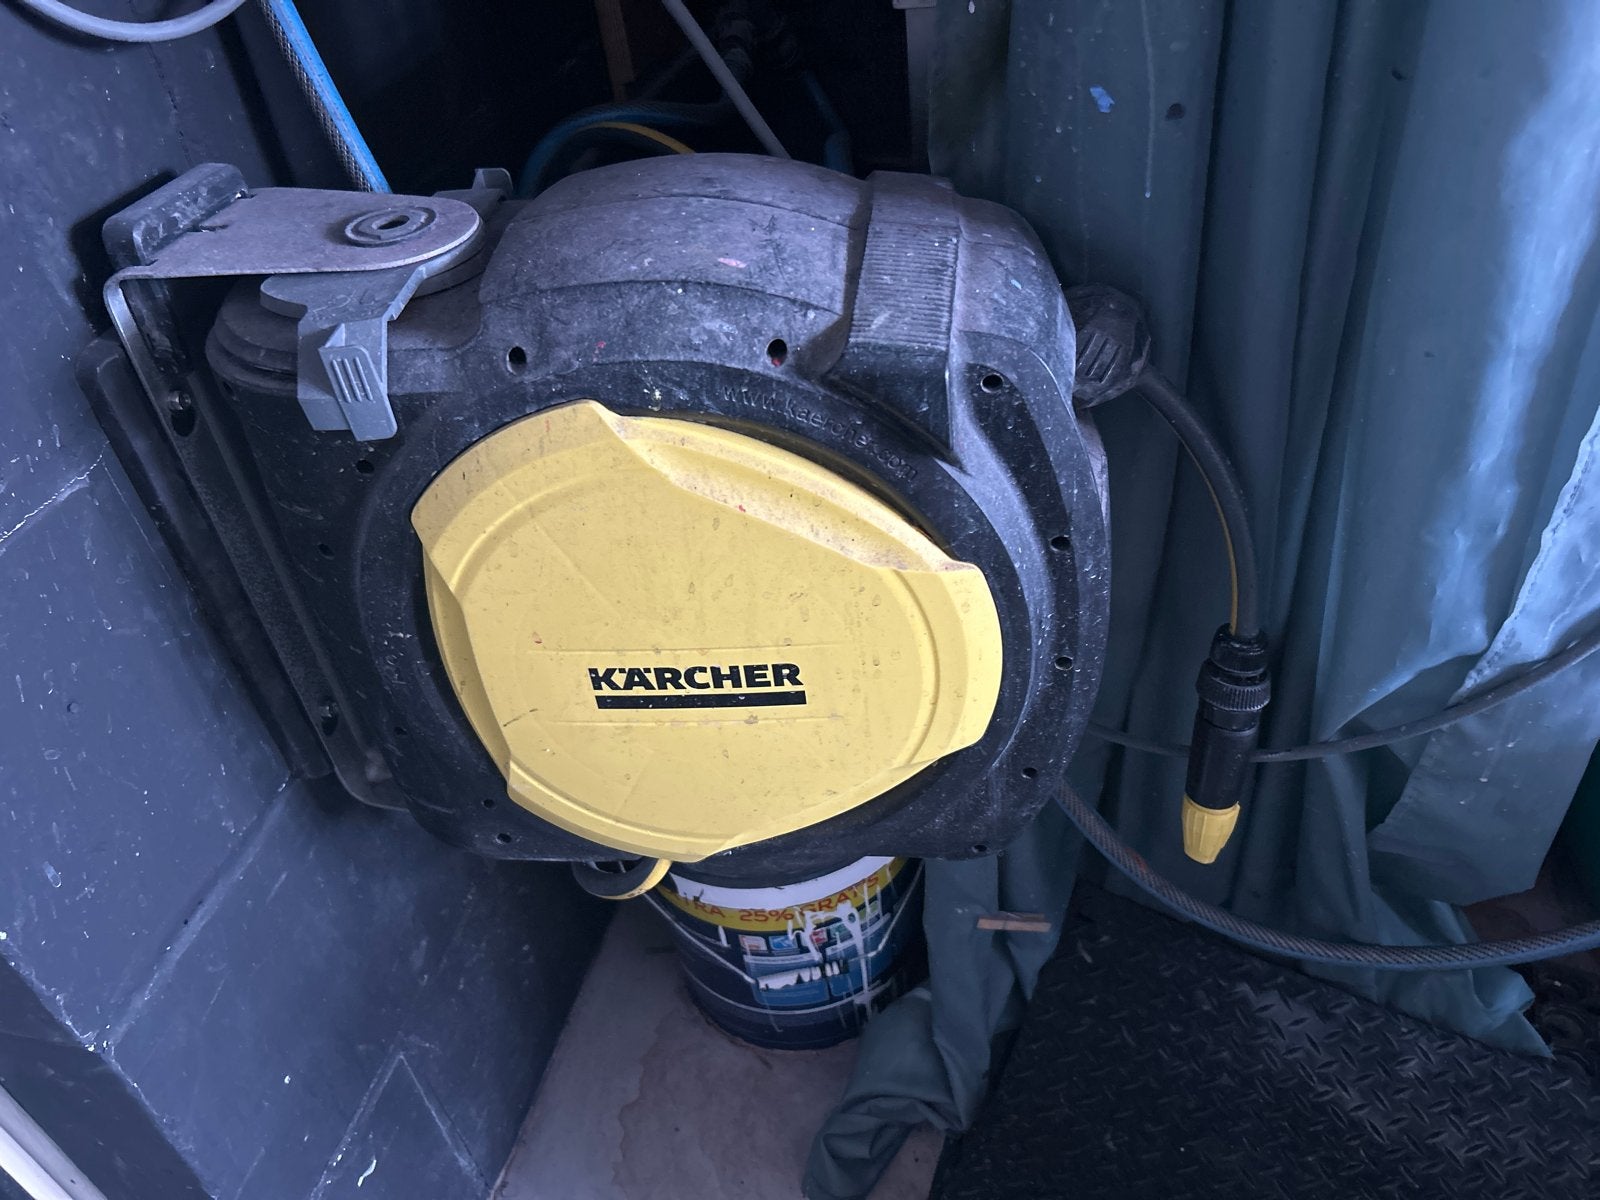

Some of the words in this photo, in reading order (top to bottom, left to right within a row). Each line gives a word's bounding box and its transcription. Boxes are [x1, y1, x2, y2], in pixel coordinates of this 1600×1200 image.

[588, 662, 804, 691] KÄRCHER
[738, 909, 795, 923] 25%
[799, 876, 879, 916] GRATS
